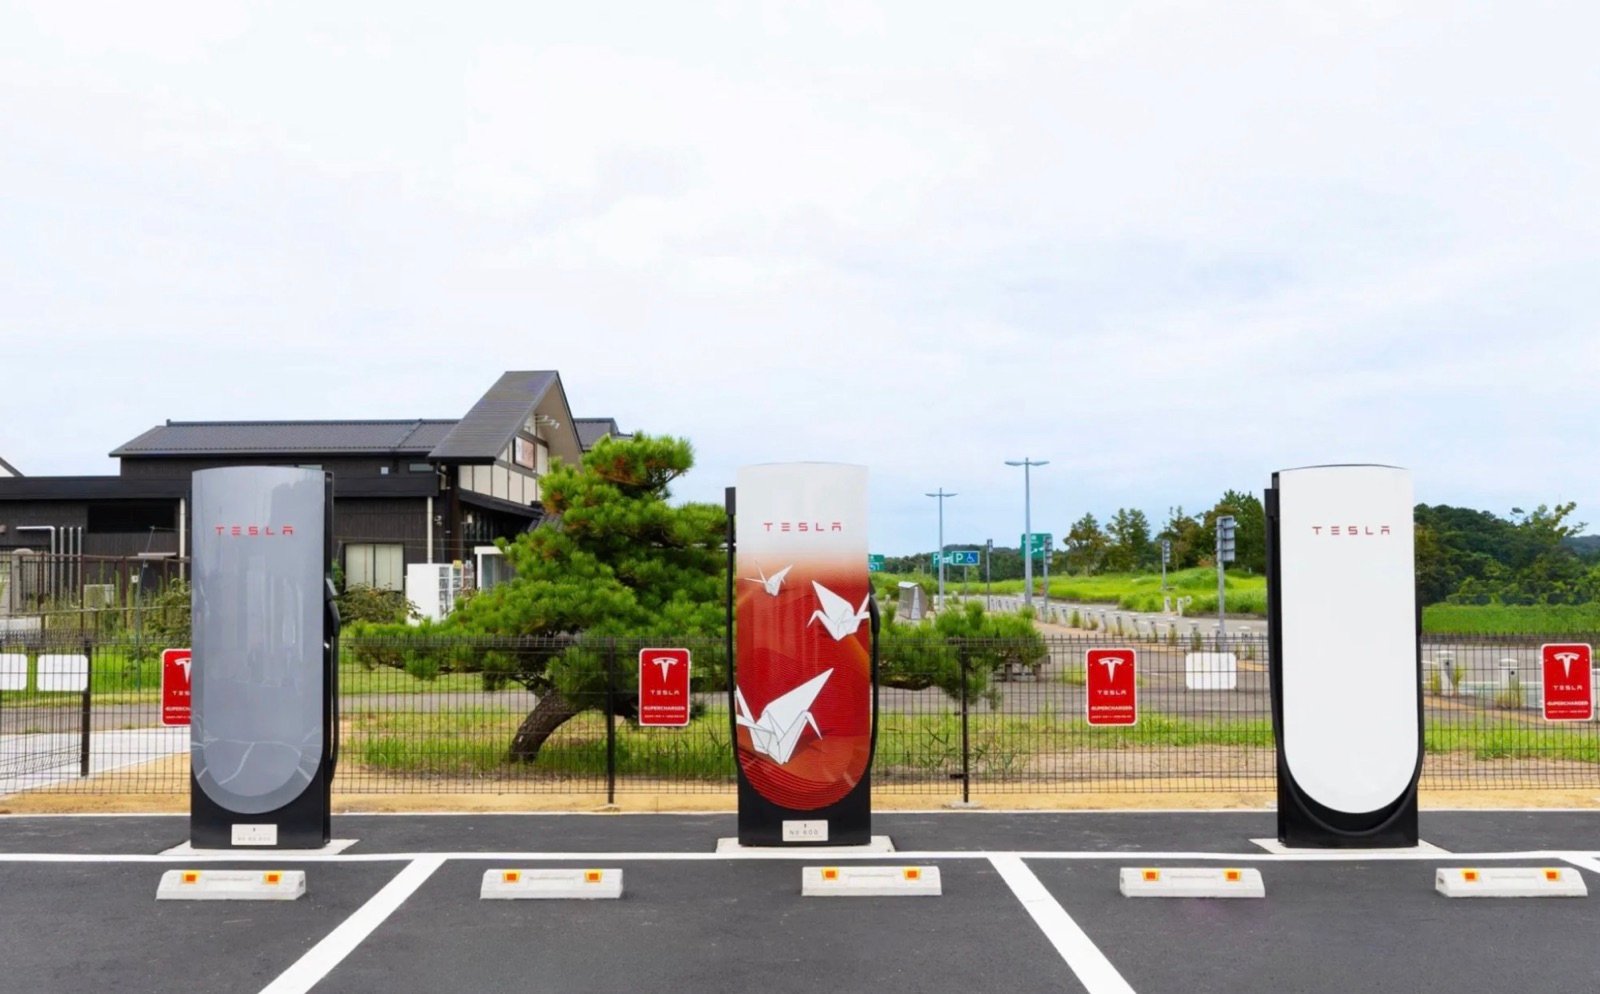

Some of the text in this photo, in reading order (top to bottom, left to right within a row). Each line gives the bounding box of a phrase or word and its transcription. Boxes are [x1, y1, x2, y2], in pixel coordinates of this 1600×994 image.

[215, 526, 293, 536] TESLA
[763, 522, 842, 532] TESLA
[1311, 526, 1390, 535] TESLA
[955, 554, 963, 563] P
